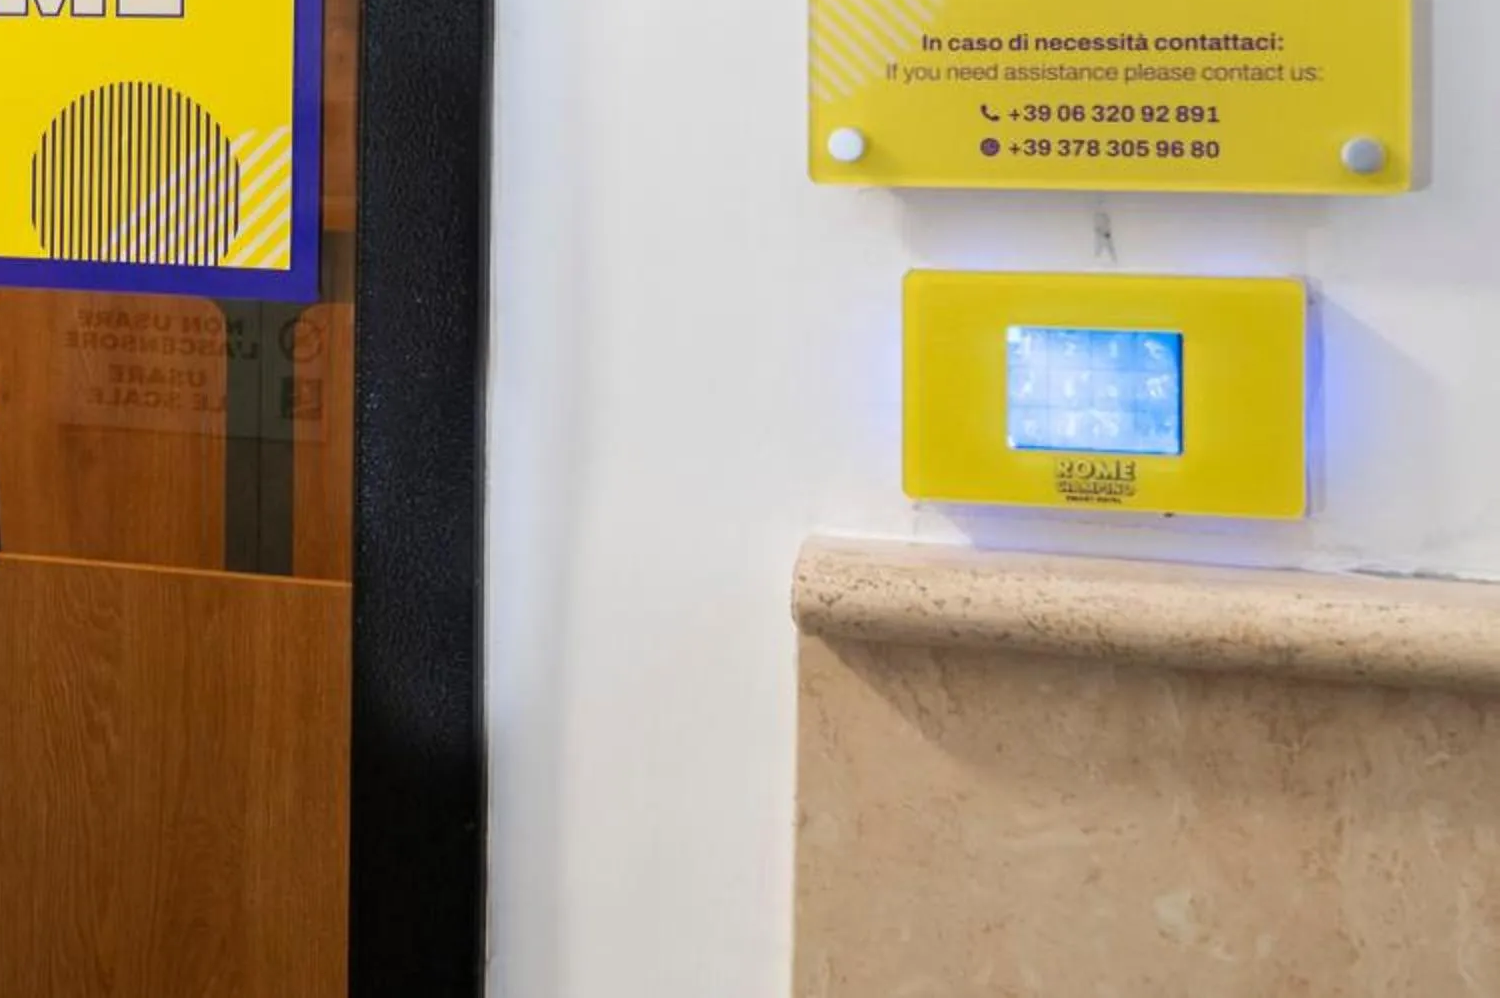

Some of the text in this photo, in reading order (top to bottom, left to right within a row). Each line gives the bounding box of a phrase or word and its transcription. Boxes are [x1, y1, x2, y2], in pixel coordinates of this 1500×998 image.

[922, 32, 1285, 52] In caso di necessità contattaci:
[886, 63, 1323, 85] If you need assistance please contact us:
[1009, 105, 1219, 123] +39 06 320 92 891
[1009, 138, 1219, 159] +39 378 305 96 80
[1056, 459, 1136, 481] ROME
